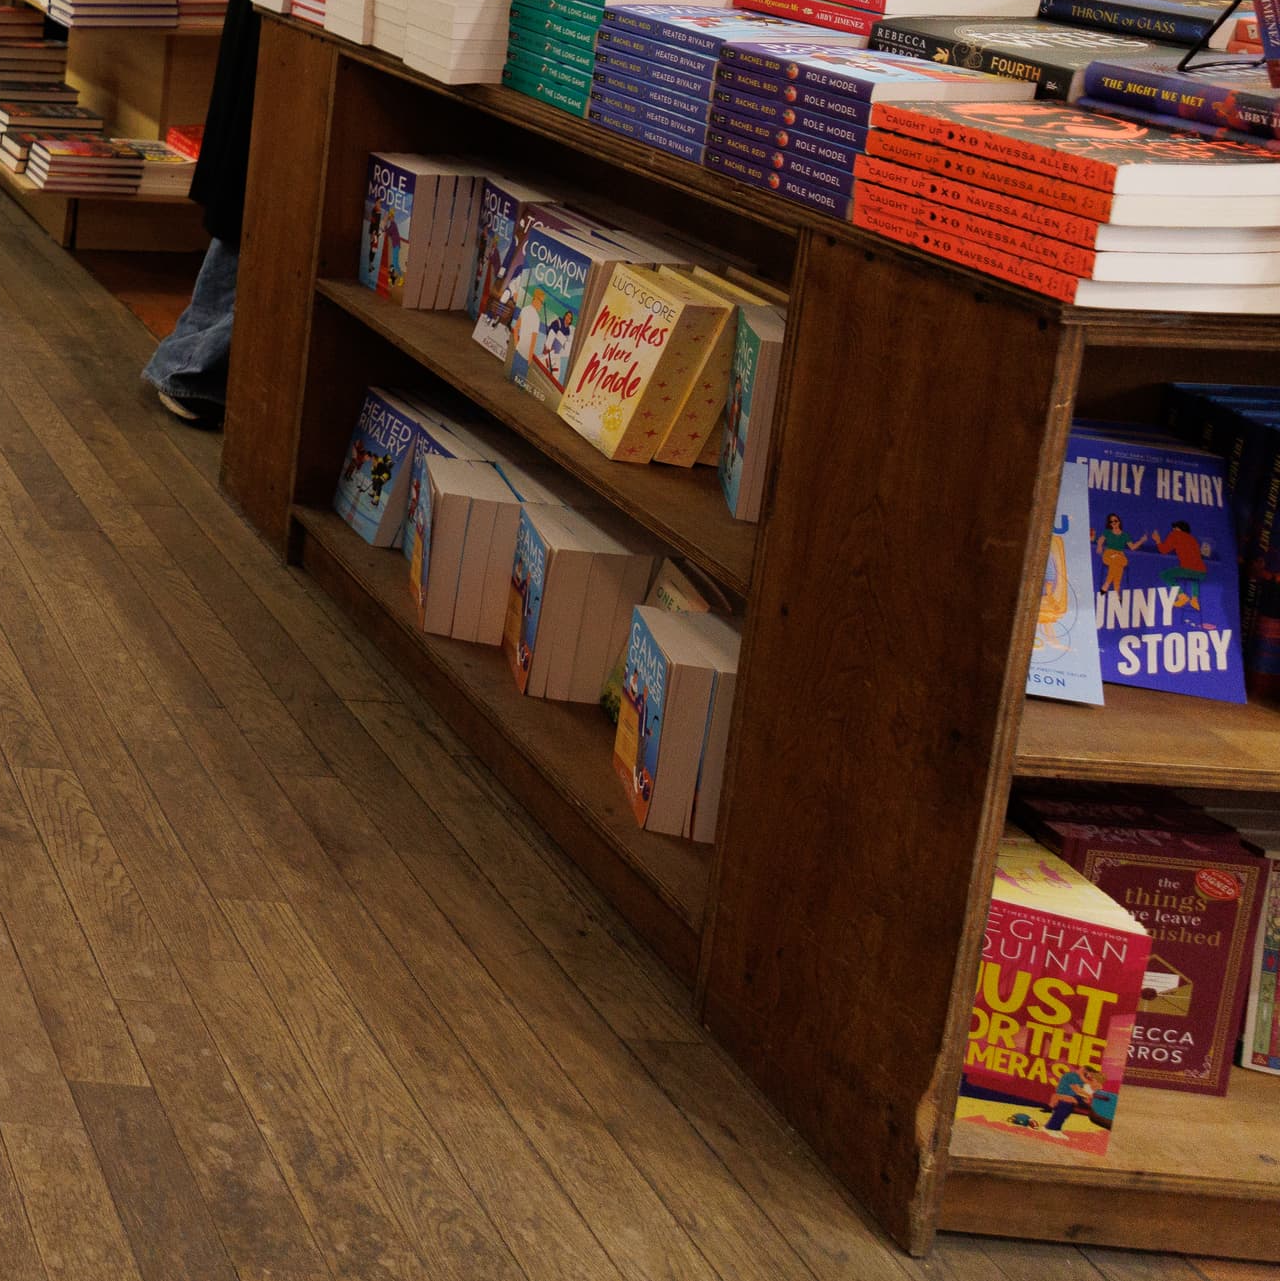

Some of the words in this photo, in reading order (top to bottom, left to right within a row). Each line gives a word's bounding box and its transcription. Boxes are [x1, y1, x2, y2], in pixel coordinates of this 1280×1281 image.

[877, 27, 927, 49] REBECCA
[1071, 5, 1120, 24] THRONE
[1136, 17, 1176, 34] GLASS
[662, 28, 687, 42] HEATED
[689, 36, 715, 49] RIVALRY
[740, 54, 763, 66] RACHEL
[766, 61, 780, 71] REID
[806, 72, 826, 85] ROLE
[829, 78, 858, 93] MODEL
[989, 55, 1042, 83] FOURTH
[1102, 77, 1123, 91] THE
[1124, 84, 1157, 97] NIGHT
[1161, 90, 1177, 102] WE
[1180, 94, 1205, 108] MET
[1238, 110, 1268, 125] ABBY
[885, 114, 925, 134] CAUGHT
[929, 127, 943, 137] UP
[984, 141, 1037, 163] NAVESSA
[1040, 155, 1079, 175] ALLEN
[373, 163, 407, 195] ROLE
[368, 185, 409, 214] MODEL
[484, 187, 512, 216] ROLE
[529, 241, 588, 284] COMMON
[534, 262, 572, 298] GOAL
[612, 274, 639, 299] LUCY
[640, 293, 677, 323] SCORE
[590, 305, 669, 347] Mistakes
[602, 341, 632, 363] Were
[576, 352, 641, 400] Made
[359, 412, 406, 458] RIVALRY
[361, 398, 413, 443] HEATED
[1156, 468, 1224, 508] HENRY
[1095, 586, 1180, 631] UNNY
[631, 622, 665, 679] GAME
[1117, 629, 1232, 677] STORY
[1123, 888, 1208, 913] things
[1157, 877, 1180, 891] the
[1198, 871, 1235, 897] SIGNED
[1146, 908, 1202, 928] leave
[986, 911, 1128, 963] EGHAN
[969, 1006, 1021, 1049] OR
[1026, 1021, 1108, 1072] THE
[964, 1041, 1071, 1088] MERAS
